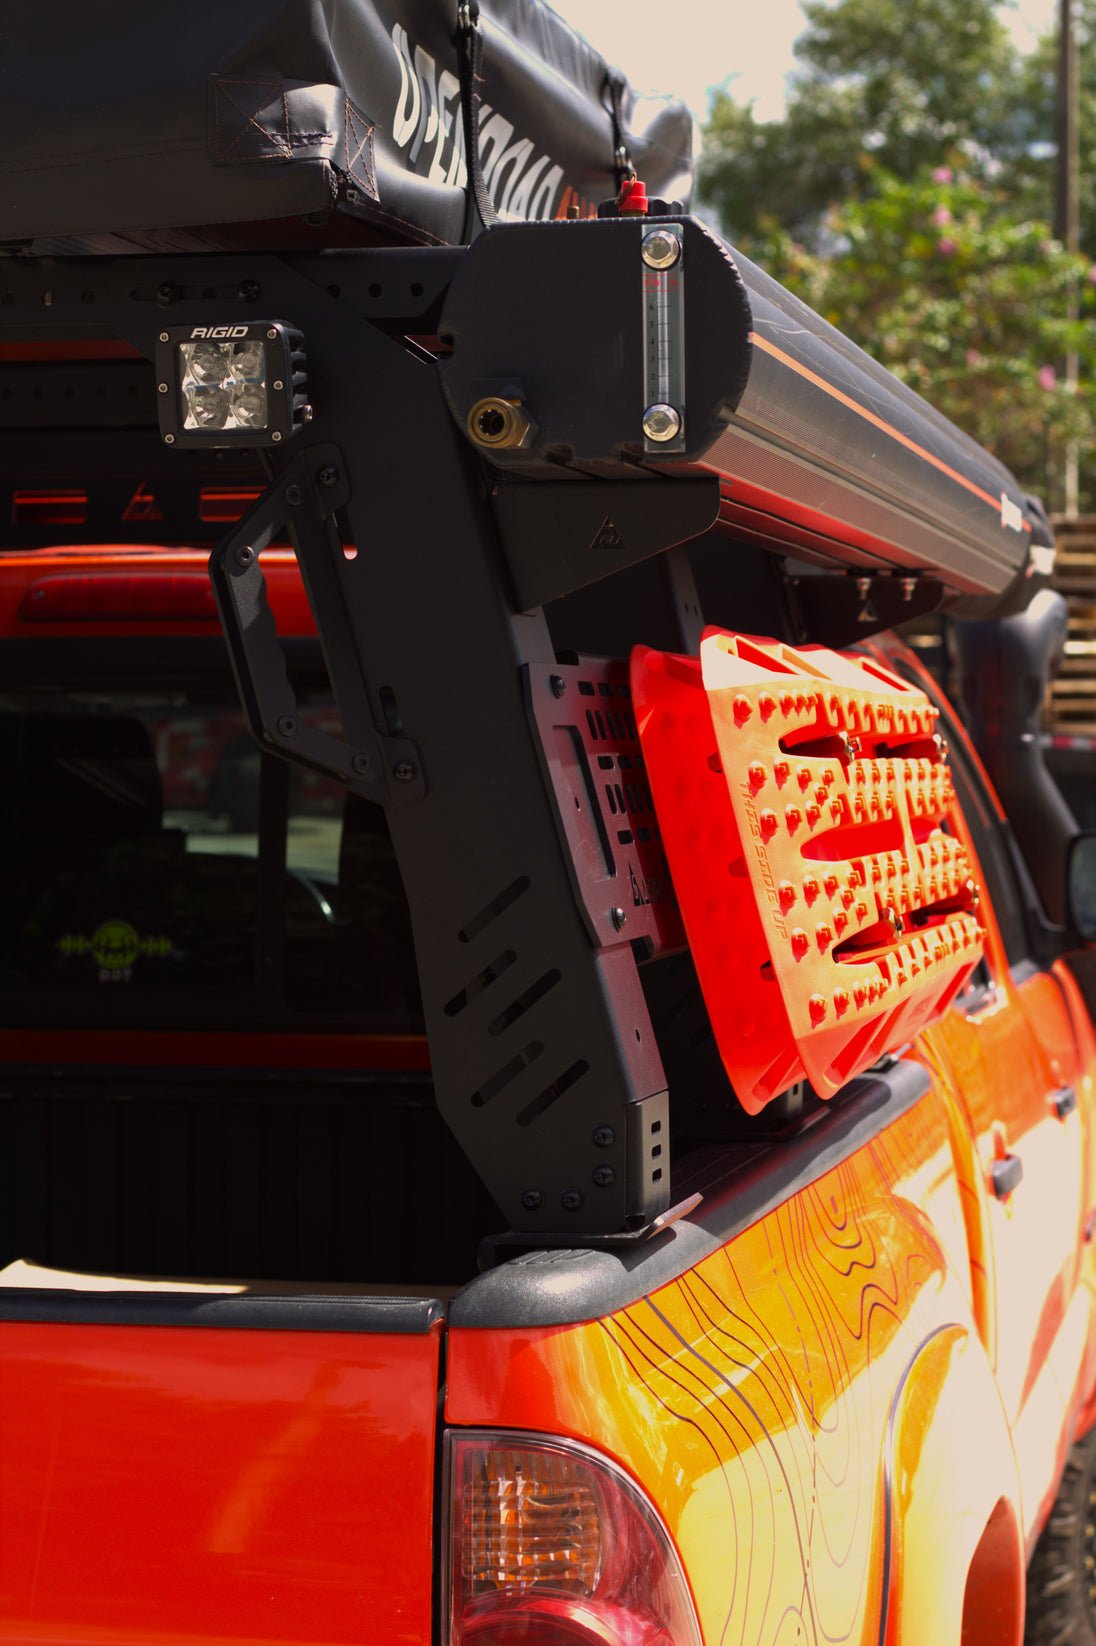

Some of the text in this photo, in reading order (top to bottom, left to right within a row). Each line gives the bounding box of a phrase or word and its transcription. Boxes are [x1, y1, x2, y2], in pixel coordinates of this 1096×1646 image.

[190, 326, 249, 338] RIGID
[739, 782, 789, 941] THIS SIDE UP
